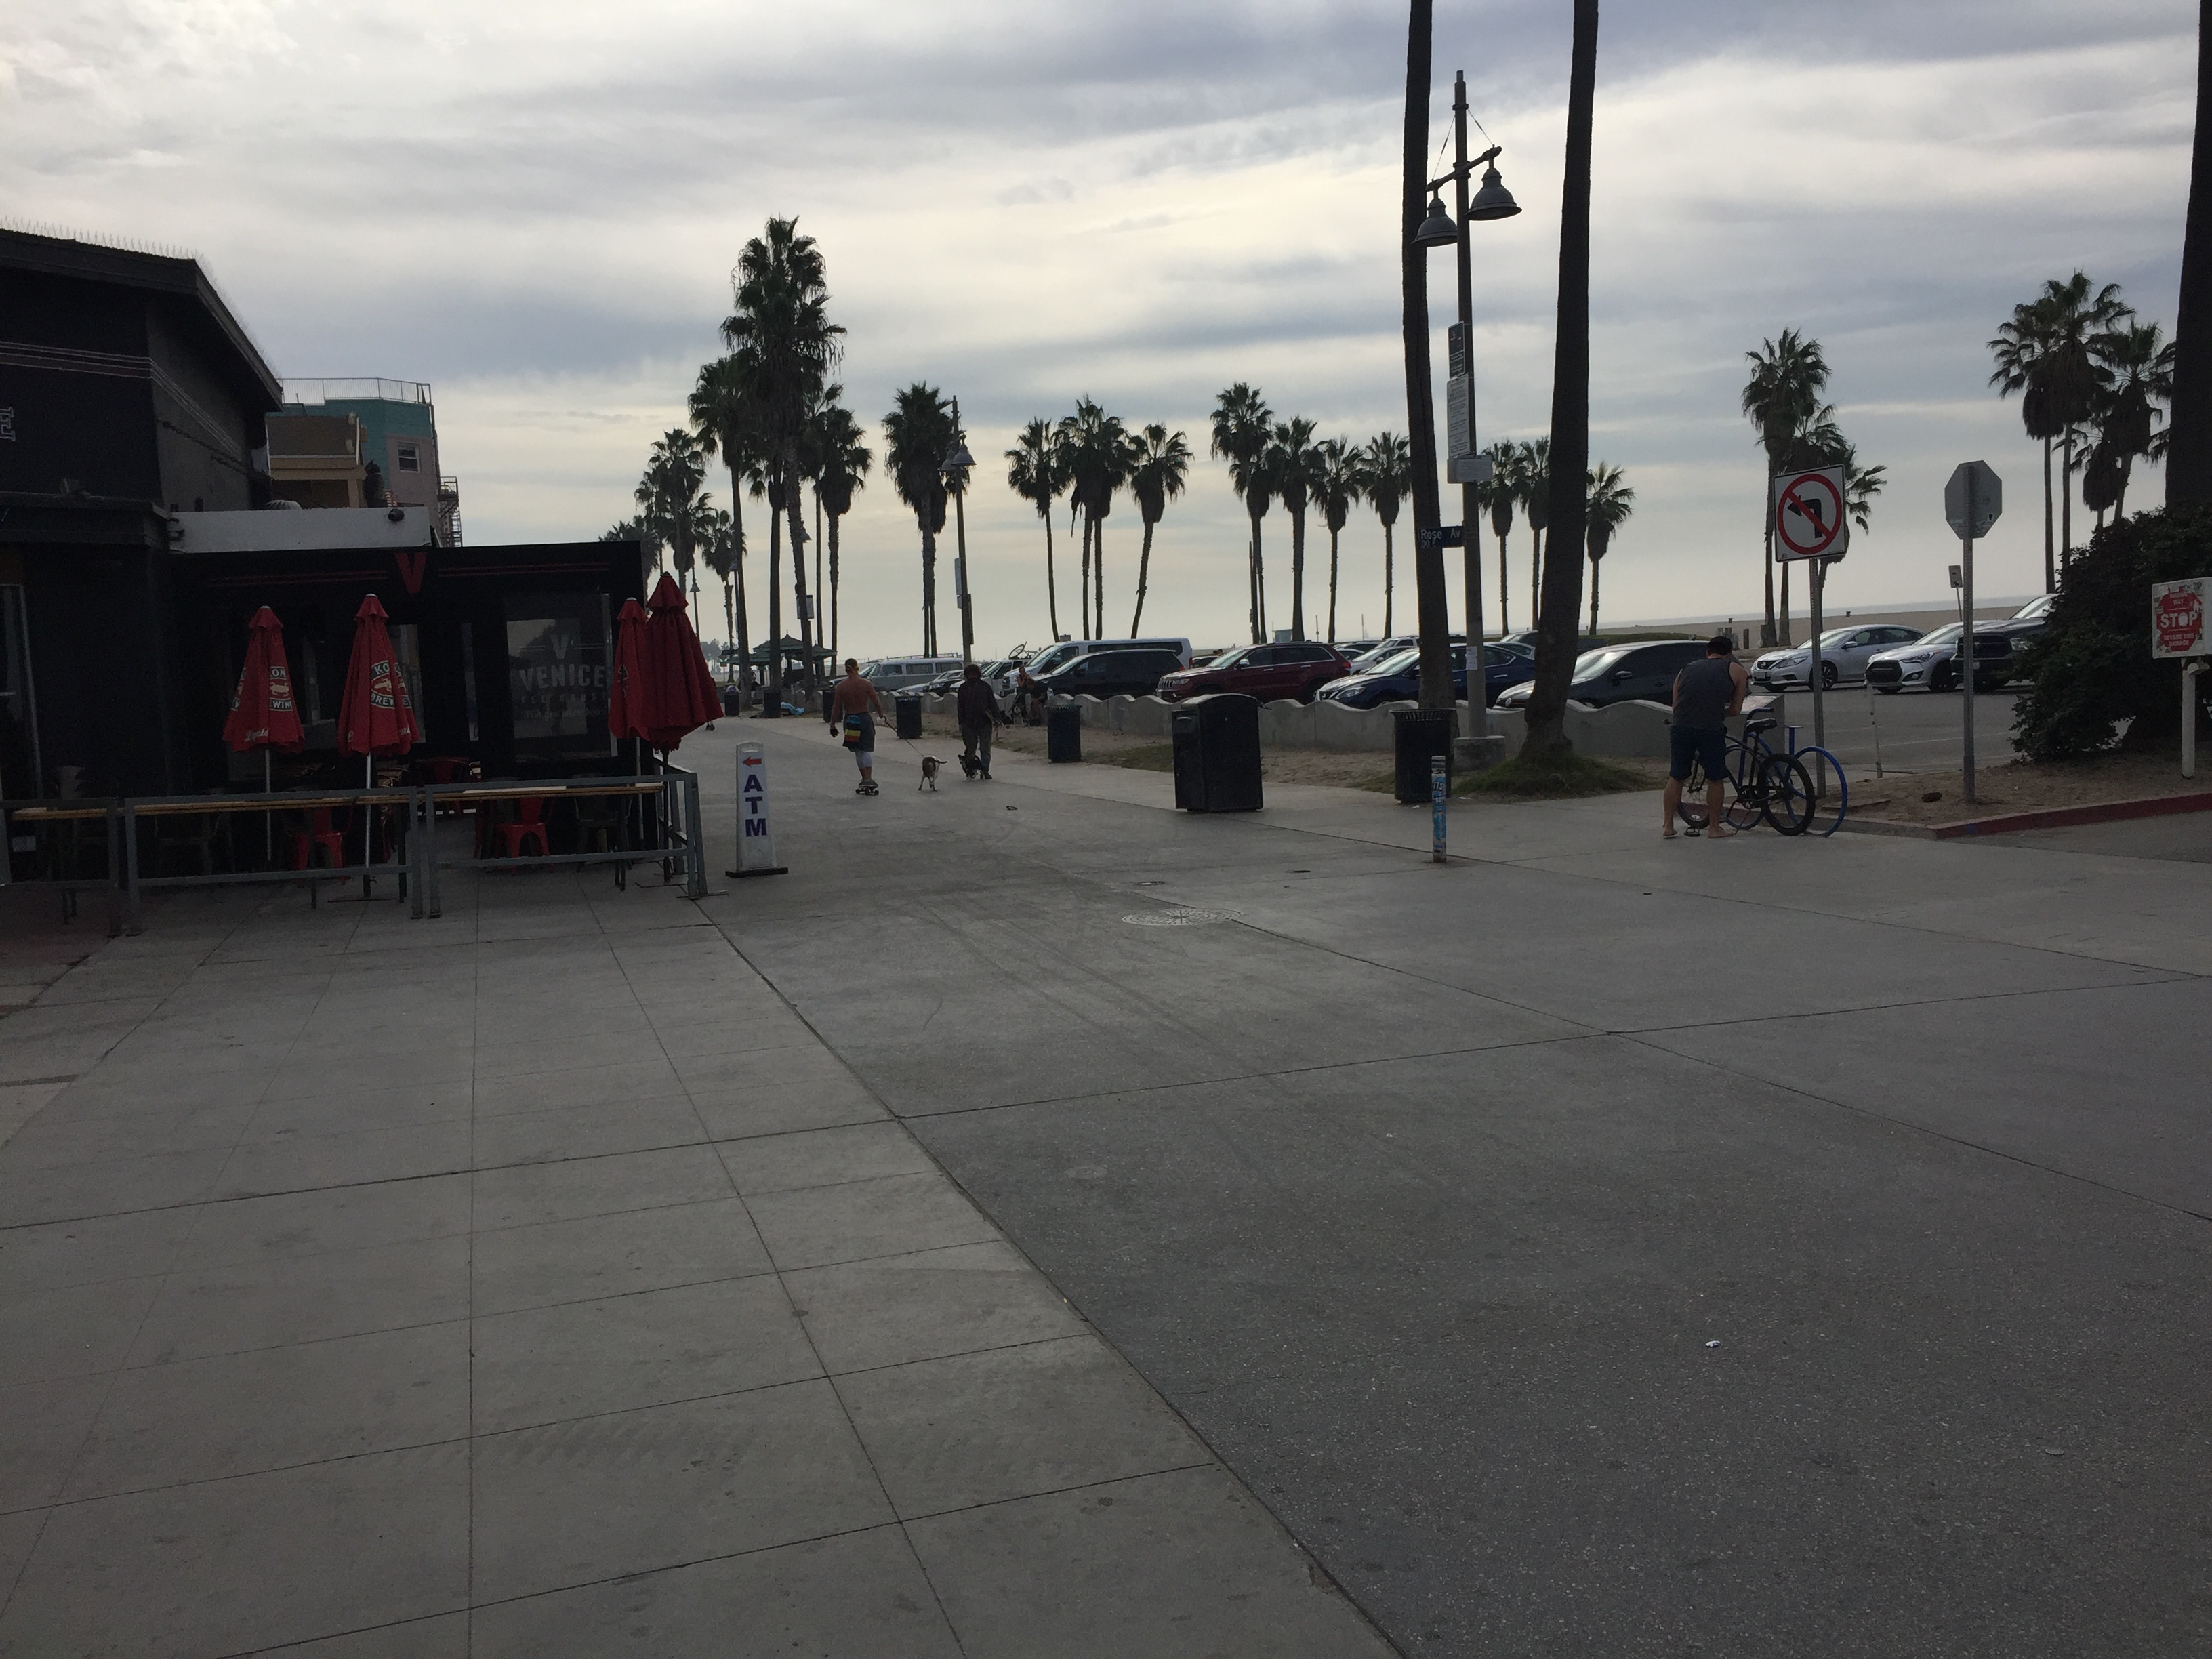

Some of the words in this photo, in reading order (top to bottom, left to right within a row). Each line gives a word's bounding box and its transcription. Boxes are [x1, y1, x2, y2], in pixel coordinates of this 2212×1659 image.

[1421, 529, 1442, 539] Rose
[1451, 528, 1460, 538] Av
[394, 552, 428, 594] V
[2160, 611, 2198, 628] STOP
[518, 663, 605, 691] VENICE
[743, 774, 766, 837] ATM
